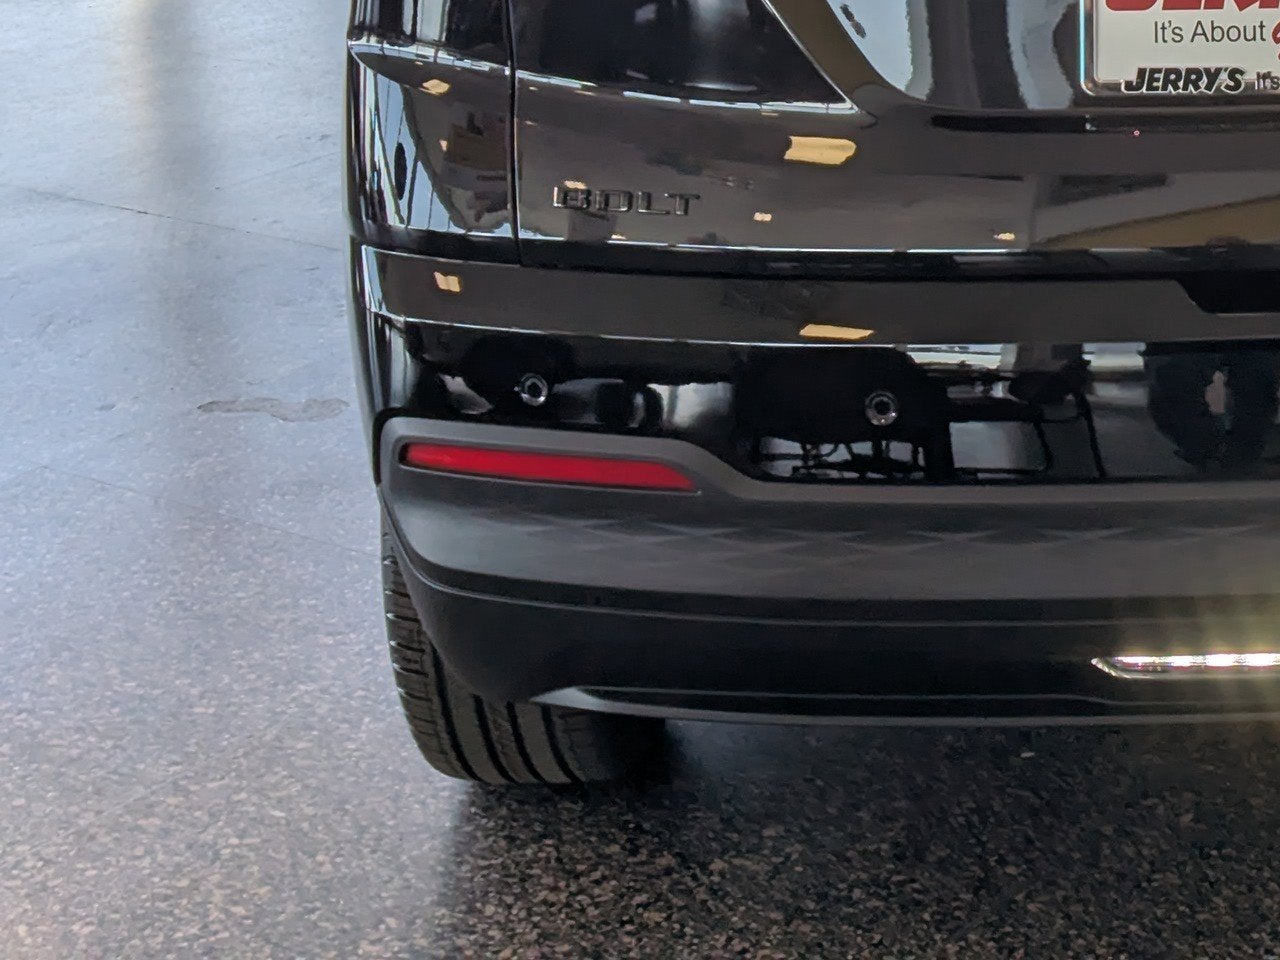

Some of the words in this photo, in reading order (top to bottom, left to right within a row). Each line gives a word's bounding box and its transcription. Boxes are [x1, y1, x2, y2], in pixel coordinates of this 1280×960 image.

[1154, 20, 1184, 43] It's
[1190, 19, 1266, 43] About
[1122, 66, 1246, 94] JERRY'S
[1255, 71, 1280, 90] It's
[553, 186, 701, 216] BOLT
